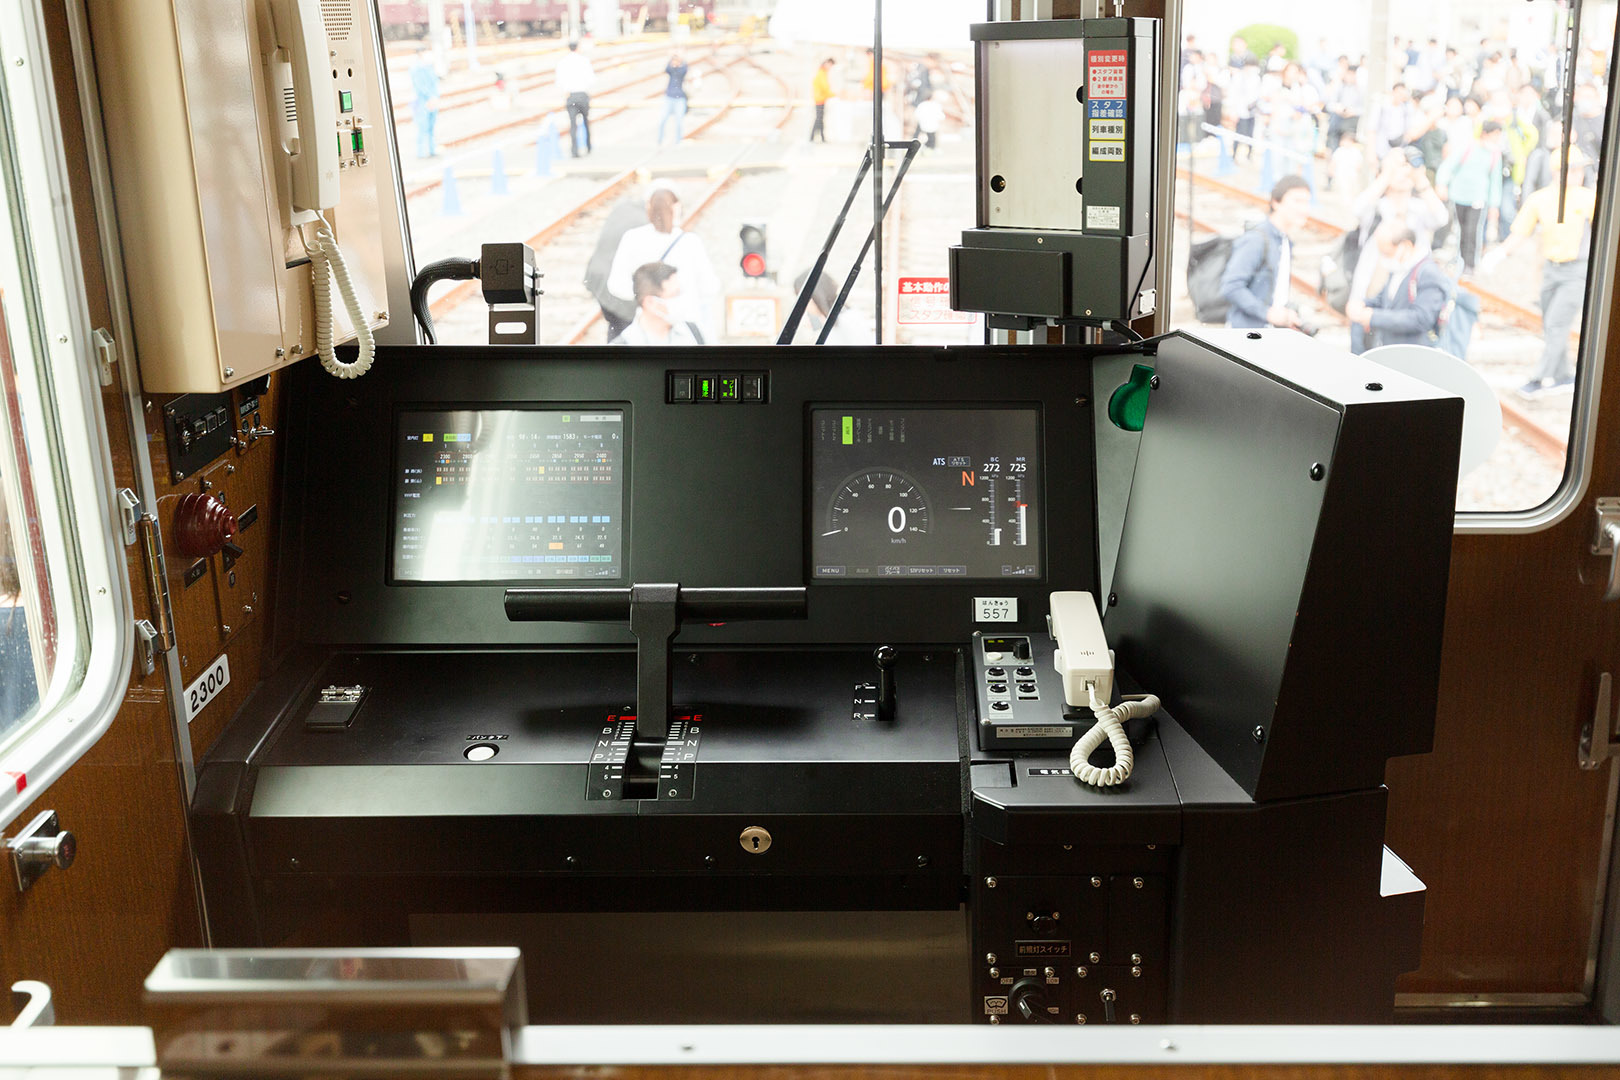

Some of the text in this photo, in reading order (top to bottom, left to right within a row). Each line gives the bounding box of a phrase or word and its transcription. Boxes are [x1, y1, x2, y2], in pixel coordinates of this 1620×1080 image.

[1092, 101, 1123, 109] スタフ
[1092, 109, 1123, 117] 指差確認
[1092, 125, 1123, 134] 列車種別
[1092, 147, 1122, 155] 編成両数
[932, 457, 946, 466] ATS
[983, 463, 1000, 472] 272
[1009, 463, 1027, 472] 725
[962, 470, 975, 487] N
[888, 507, 906, 533] 0
[983, 608, 1009, 619] 557
[191, 665, 224, 713] 2300
[602, 727, 612, 735] B
[690, 726, 700, 734] B
